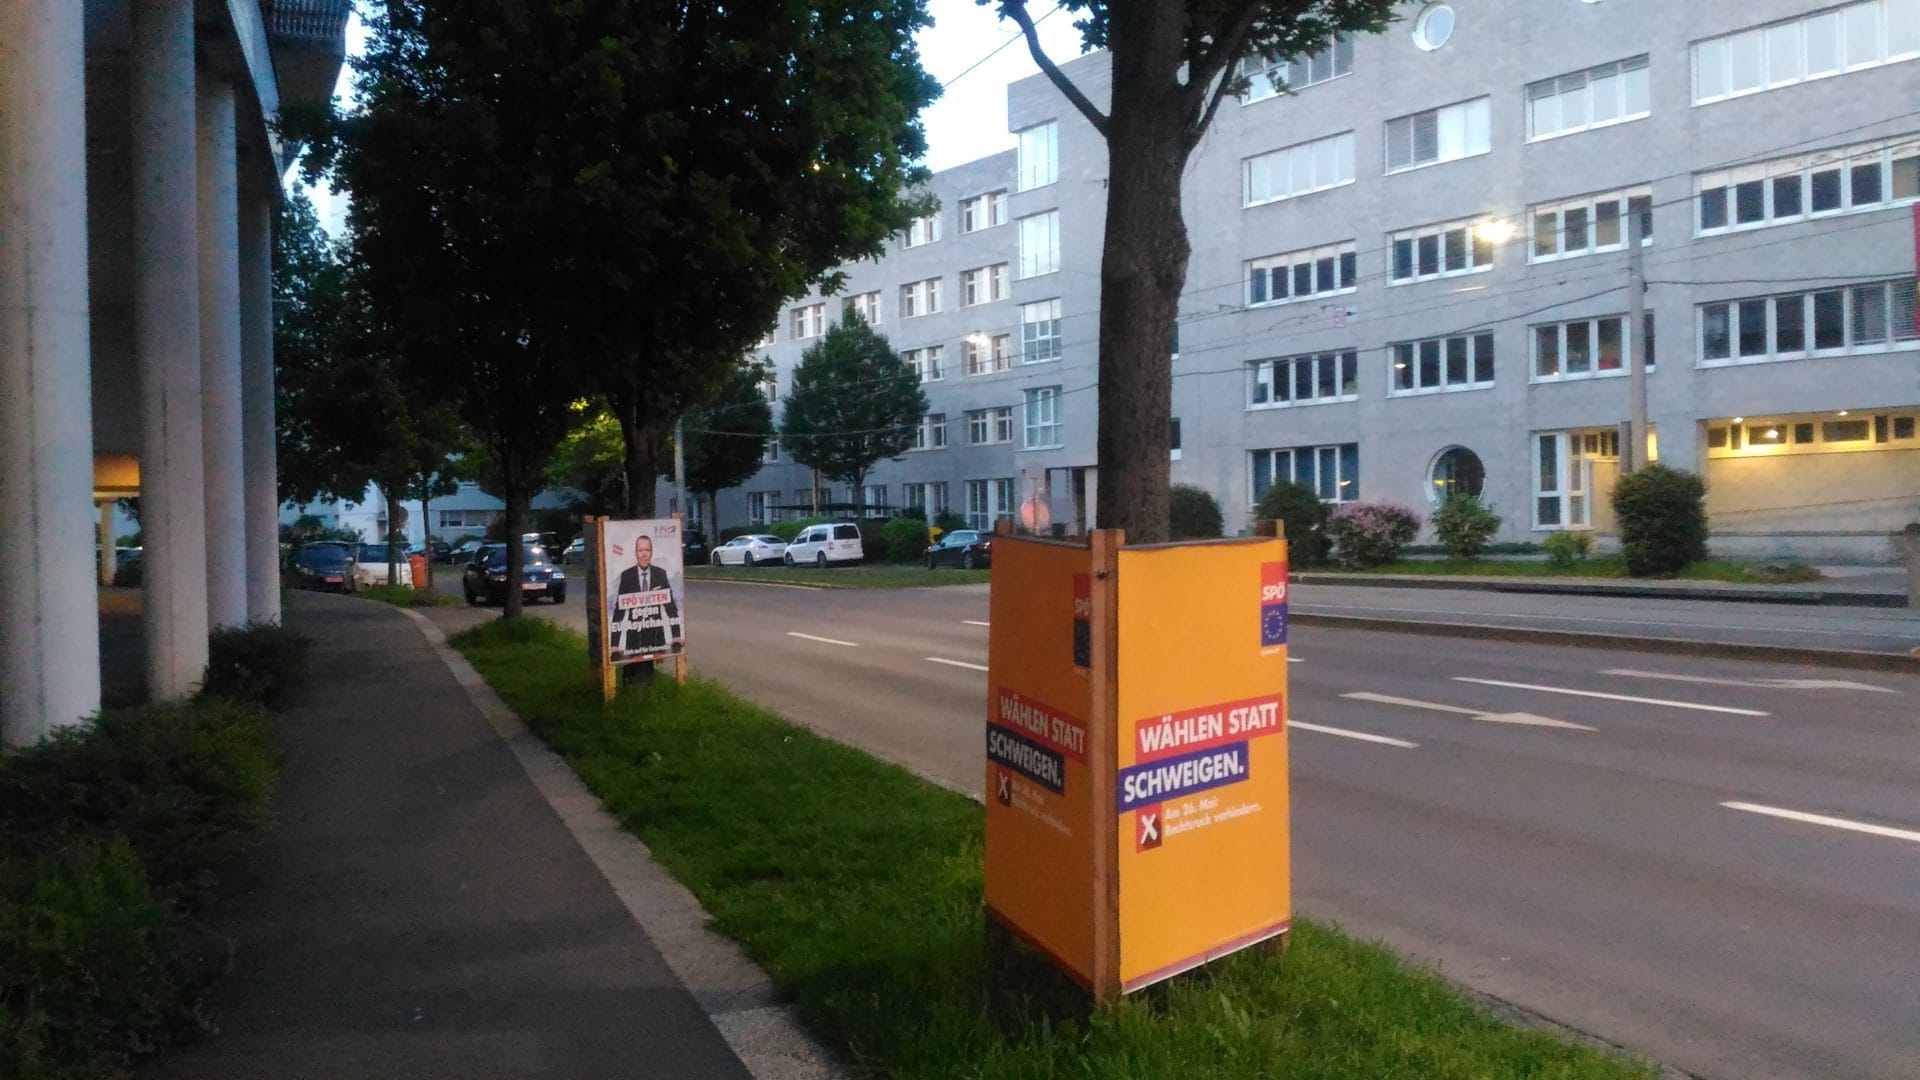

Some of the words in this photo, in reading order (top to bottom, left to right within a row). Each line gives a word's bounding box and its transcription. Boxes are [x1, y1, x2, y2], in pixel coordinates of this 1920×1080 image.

[1262, 581, 1286, 601] SPÖ
[1000, 694, 1049, 738] WÄHLEN
[1051, 717, 1085, 754] STATT
[1139, 715, 1223, 753] WÄHLEN
[1228, 702, 1279, 734] STATT
[989, 730, 1062, 787] SCHWEIGEN.
[1124, 751, 1244, 803] SCHWEIGEN.
[1164, 814, 1212, 837] Rechtsruck
[1165, 808, 1180, 820] Am
